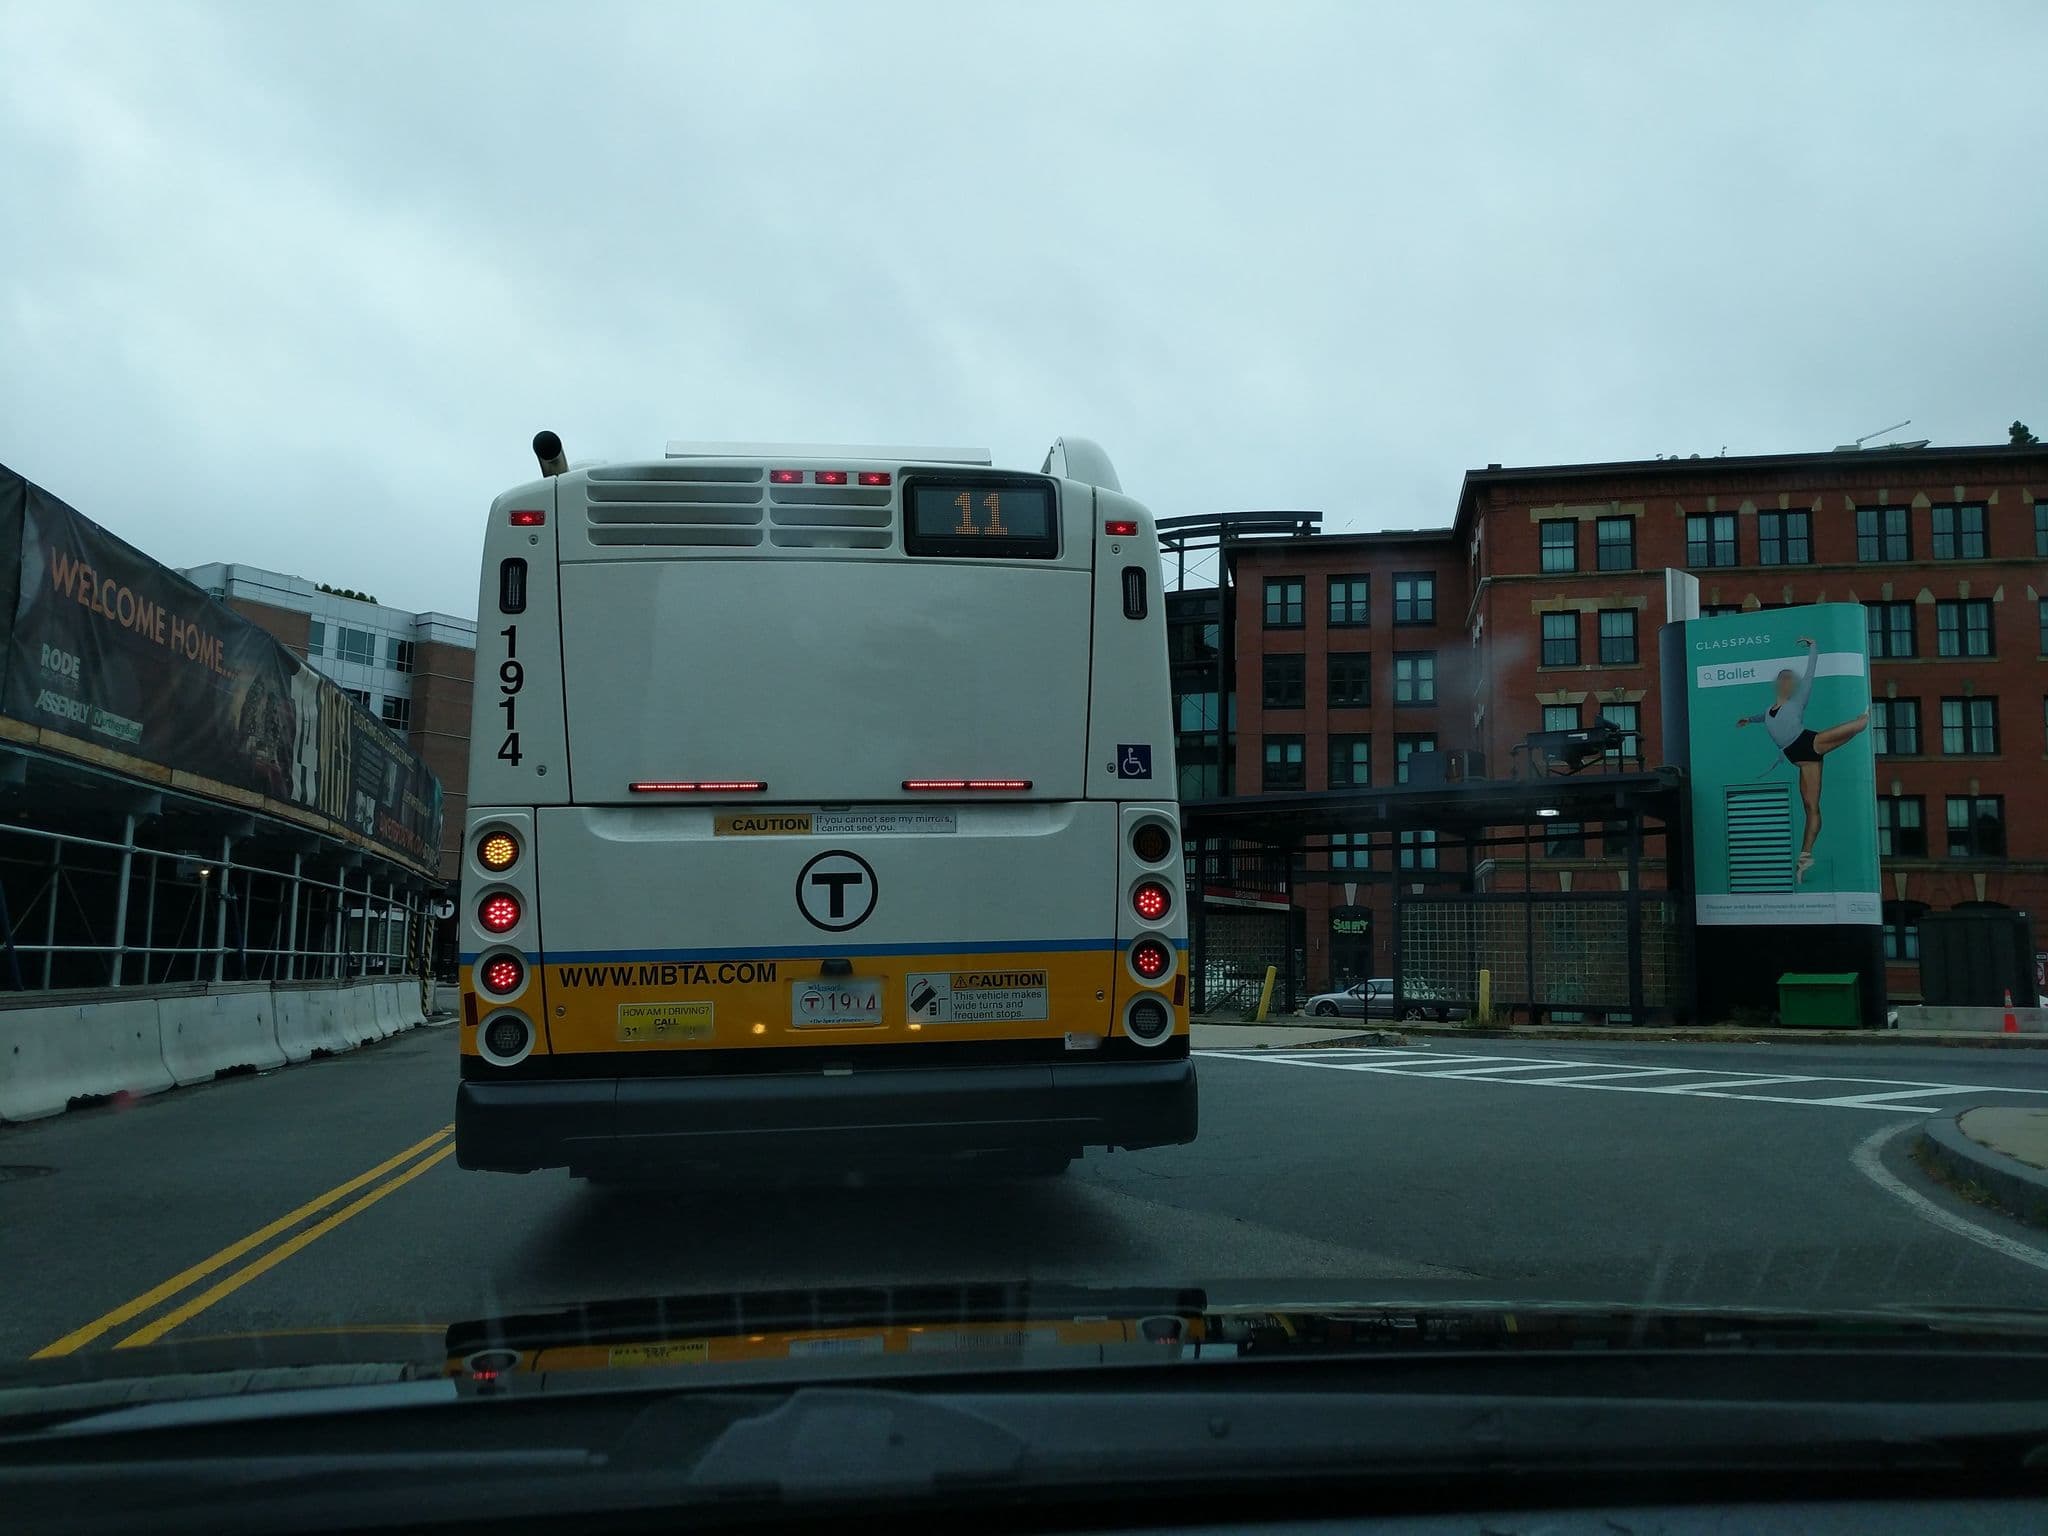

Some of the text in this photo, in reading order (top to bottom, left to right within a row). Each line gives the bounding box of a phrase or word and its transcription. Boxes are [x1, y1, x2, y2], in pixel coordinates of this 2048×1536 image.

[952, 491, 1008, 536] 11
[52, 547, 166, 645] WELCOME
[1696, 634, 1771, 651] CLASSPASS
[41, 643, 81, 680] RODE
[1716, 666, 1756, 682] Ballet
[497, 624, 524, 768] 1914
[34, 688, 90, 724] ASSEMBLY
[732, 818, 810, 832] CAUTION
[816, 815, 824, 824] If
[824, 816, 844, 826] you
[845, 815, 878, 824] cannot
[879, 816, 896, 824] see
[898, 816, 913, 826] my
[816, 824, 820, 832] I
[821, 824, 854, 832] cannot
[874, 824, 896, 834] you.
[811, 872, 863, 918] T
[559, 963, 777, 988] WWW.MBTA.COM
[968, 973, 1043, 987] CAUTION
[954, 990, 1042, 1001] This vehicle makes
[623, 1006, 710, 1016] HOW AM I DRIVING?
[953, 1000, 1024, 1010] wide turns and
[654, 1018, 679, 1026] CALL
[953, 1010, 1024, 1020] frequent stops.
